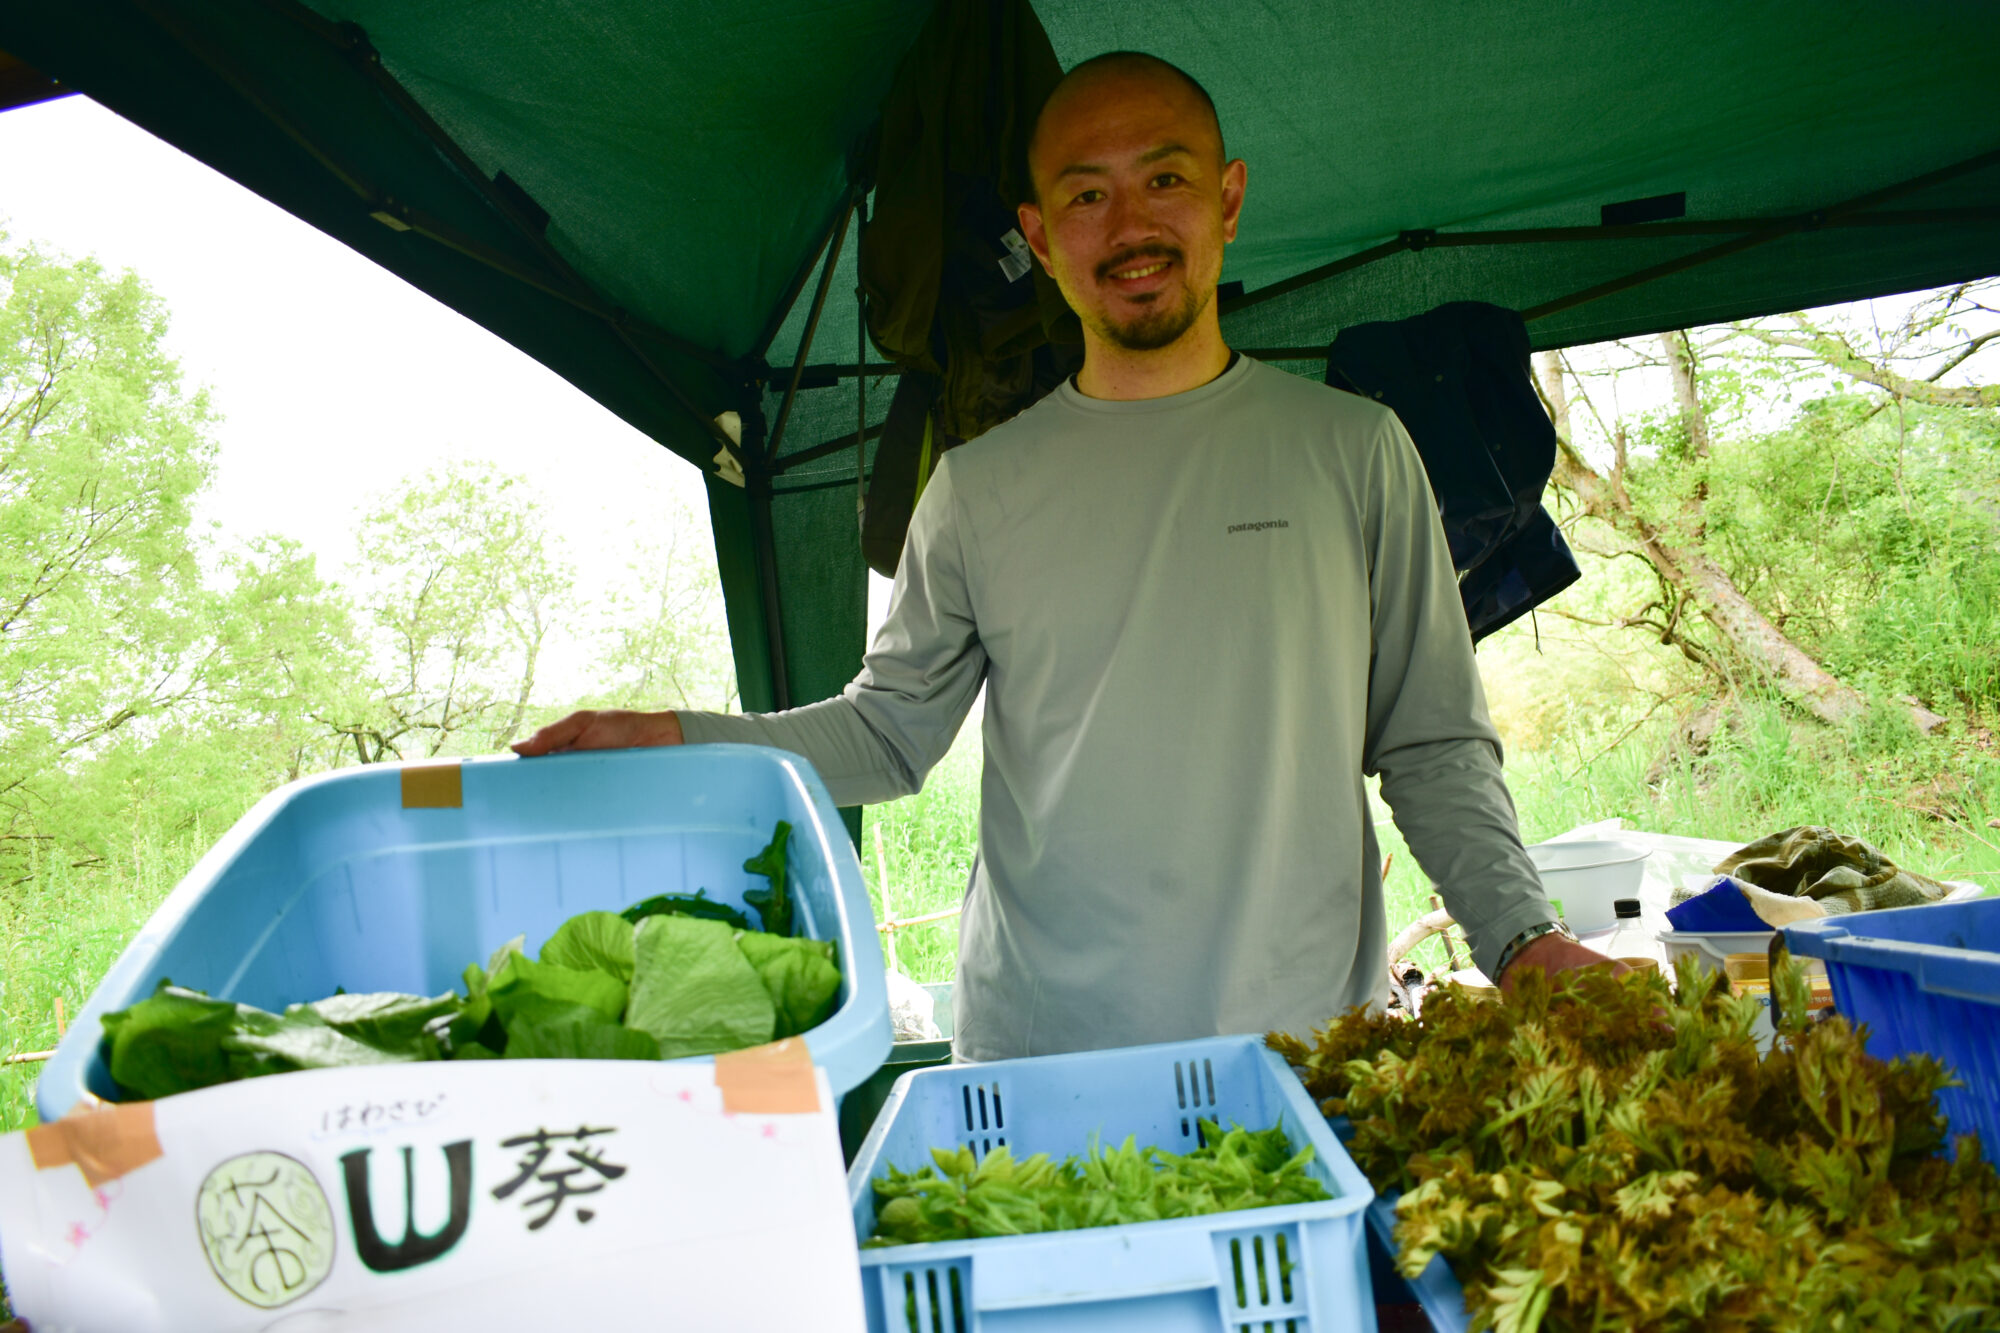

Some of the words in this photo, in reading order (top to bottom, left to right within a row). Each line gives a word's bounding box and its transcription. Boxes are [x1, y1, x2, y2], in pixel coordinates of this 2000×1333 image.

[1227, 519, 1289, 533] patagonia
[321, 1092, 447, 1132] はわさび
[339, 1125, 627, 1273] 山葵
